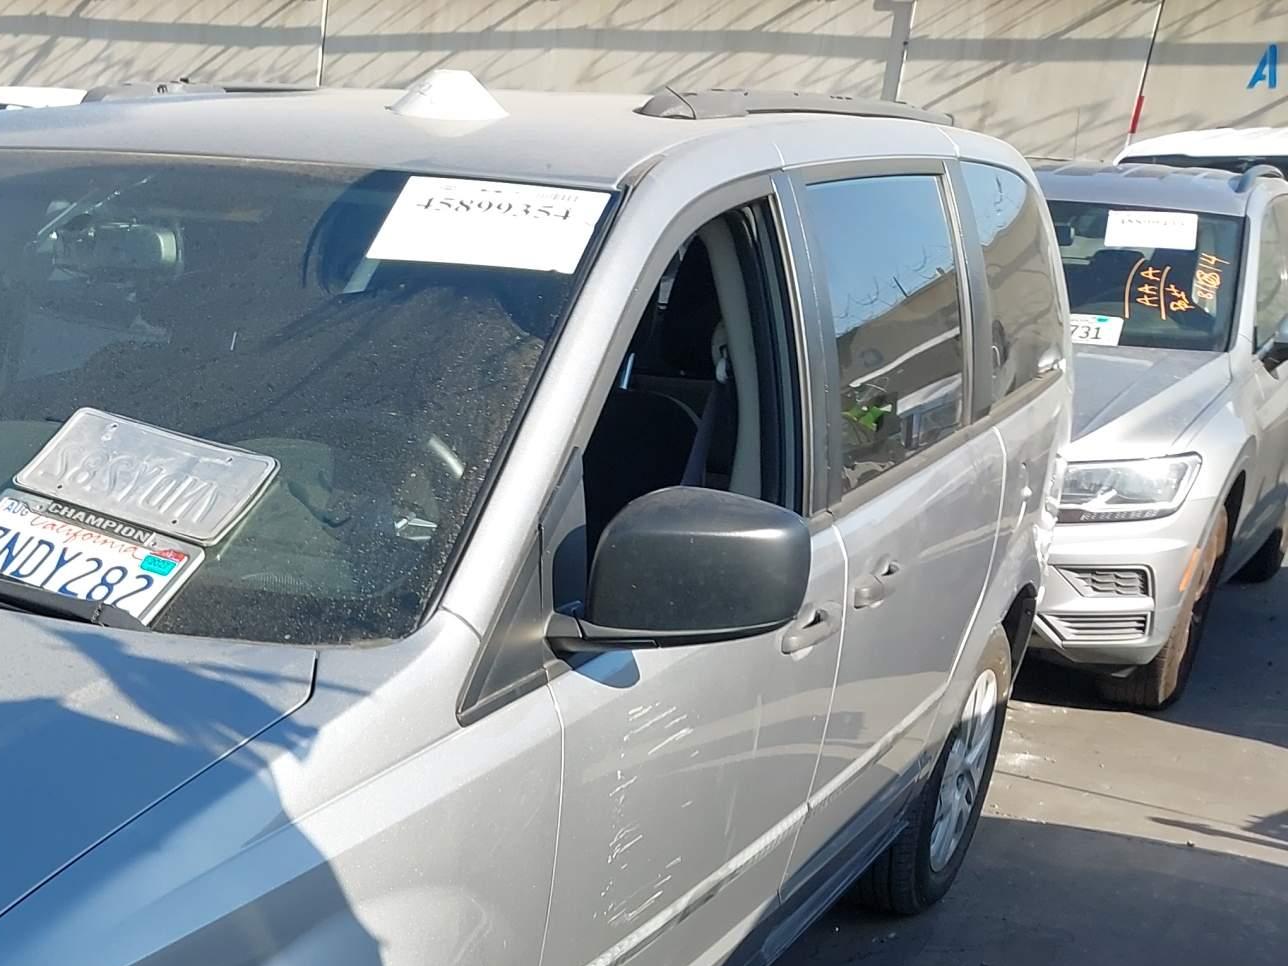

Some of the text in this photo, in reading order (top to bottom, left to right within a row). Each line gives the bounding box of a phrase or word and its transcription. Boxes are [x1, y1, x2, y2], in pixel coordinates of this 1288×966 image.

[416, 197, 572, 220] 45899354
[30, 516, 143, 560] California
[48, 502, 151, 543] CHAMPION
